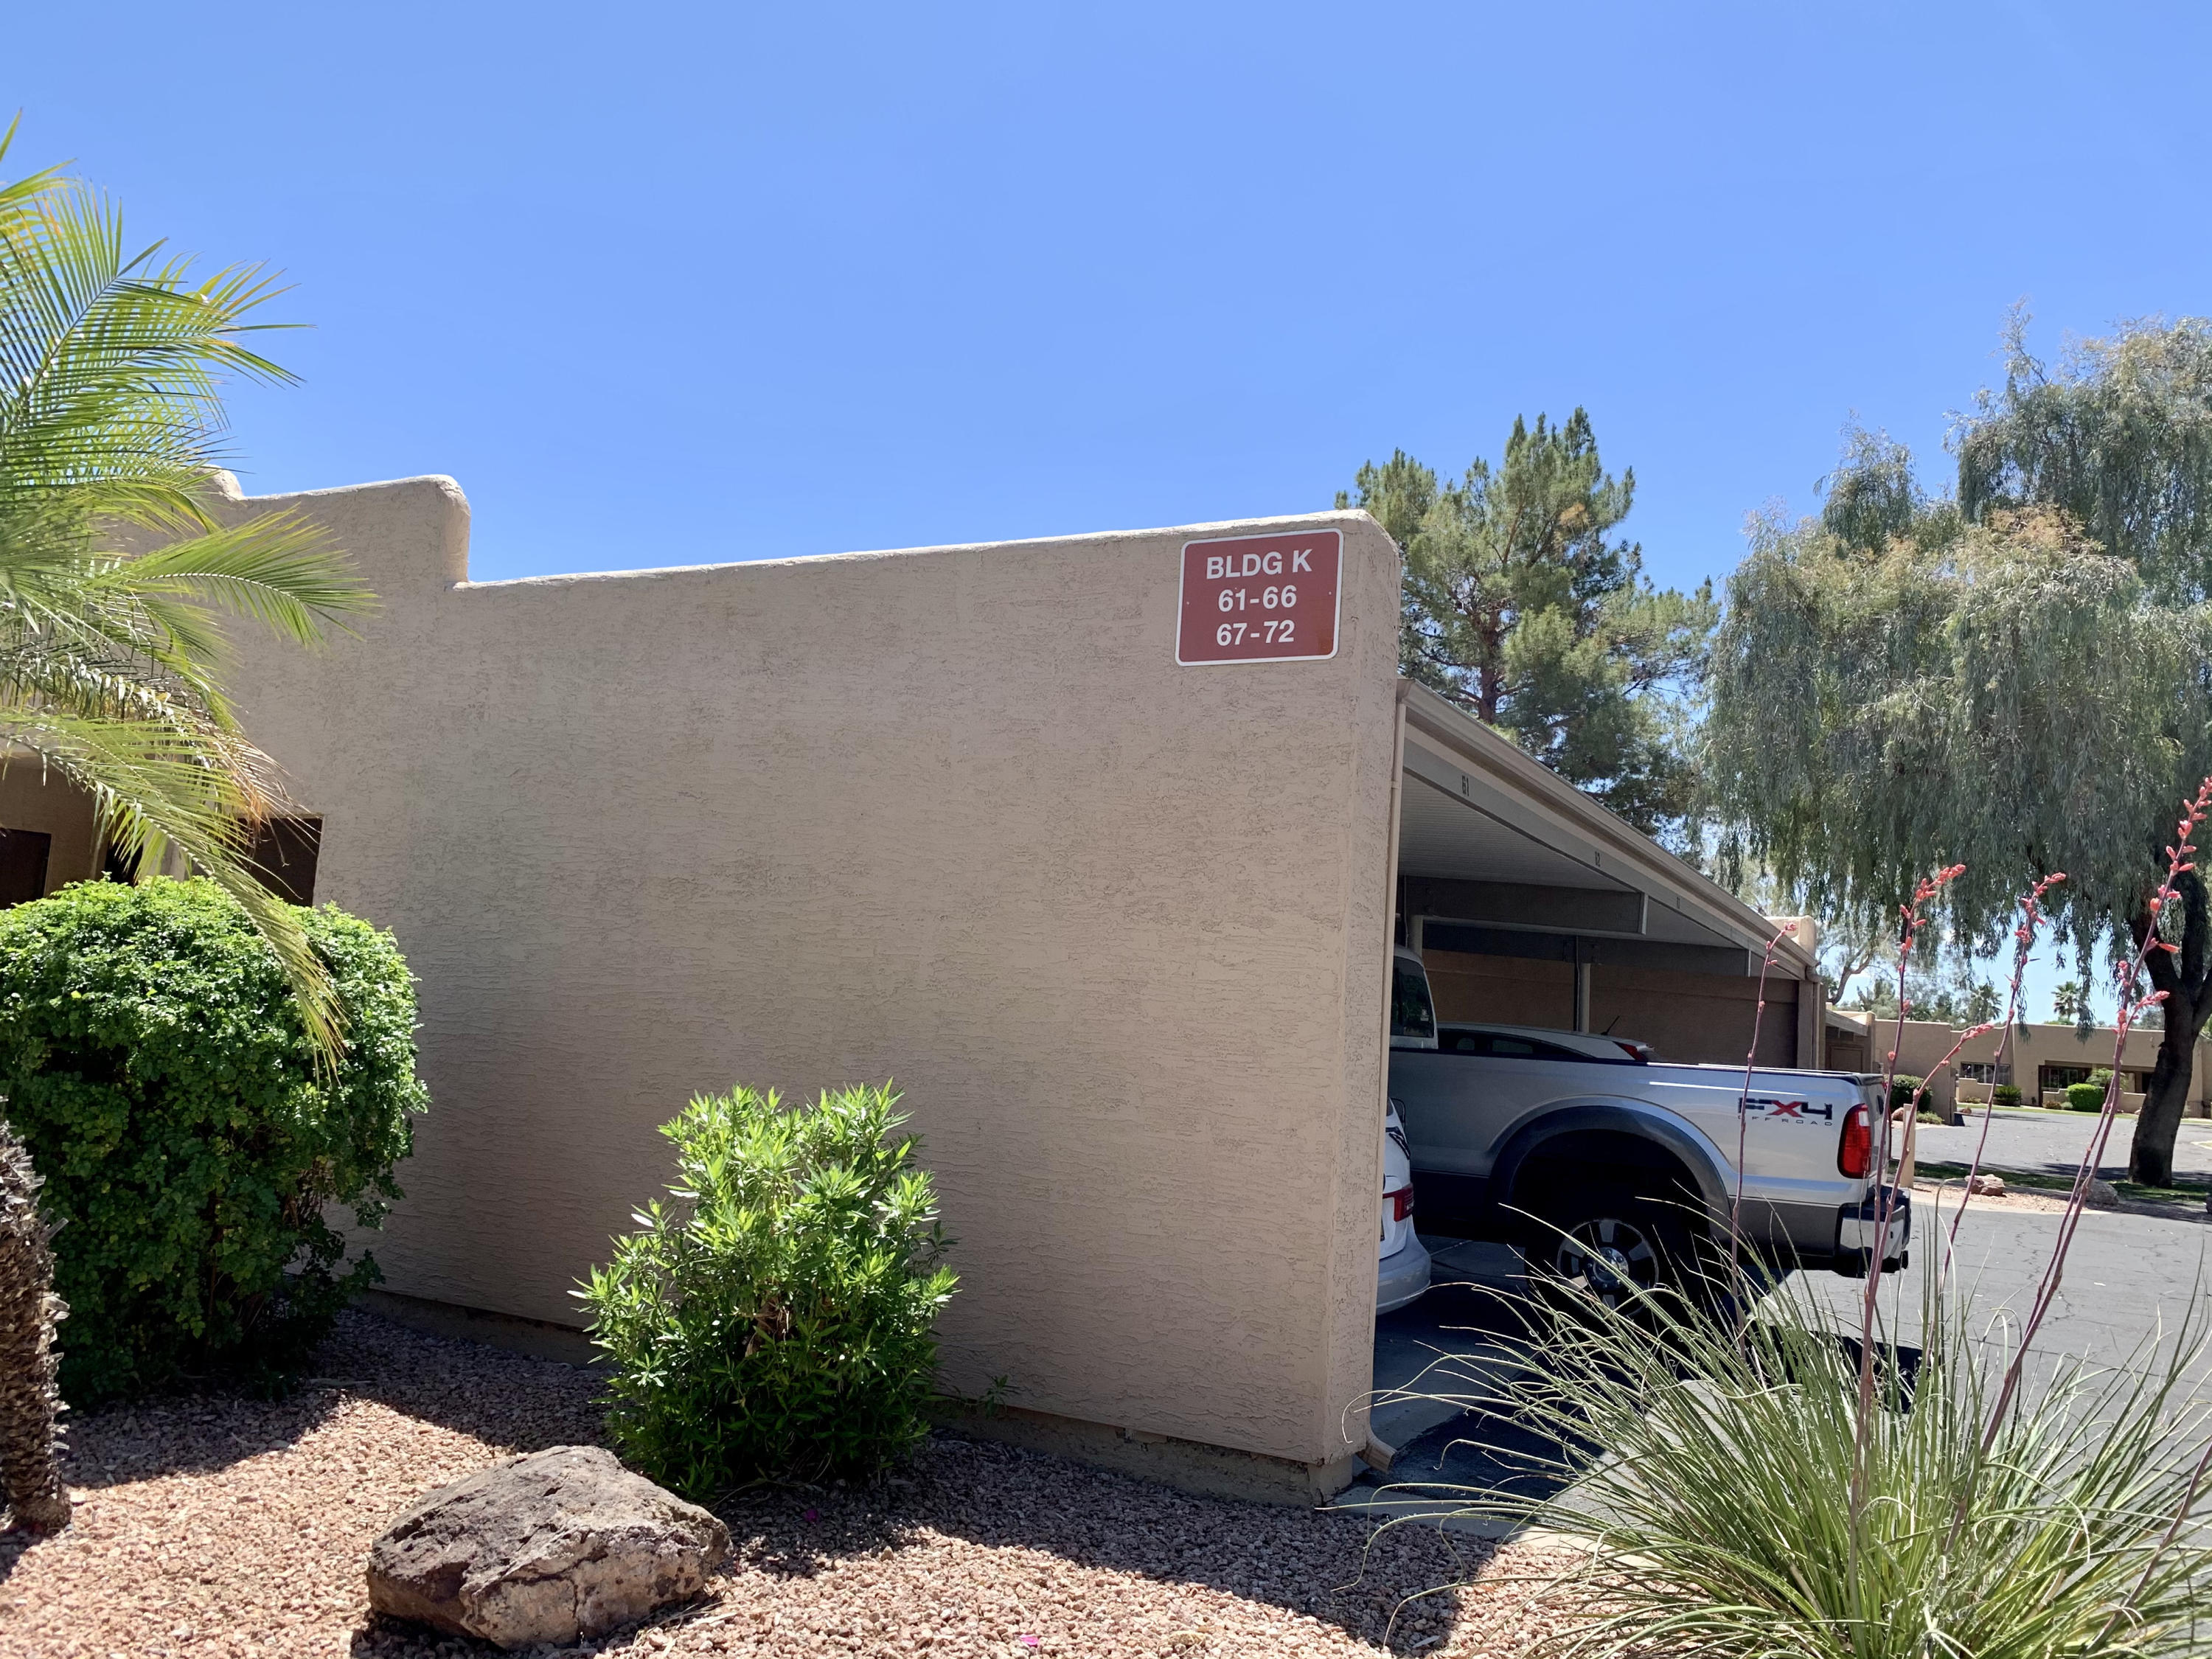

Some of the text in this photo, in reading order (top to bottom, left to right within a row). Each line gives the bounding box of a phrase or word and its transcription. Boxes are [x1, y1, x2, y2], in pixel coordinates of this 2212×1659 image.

[1206, 549, 1312, 580] BLDG K
[1218, 585, 1297, 612] 61-66
[1217, 619, 1295, 646] 67-72
[1461, 775, 1470, 796] 61
[1738, 1097, 1833, 1120] FX4
